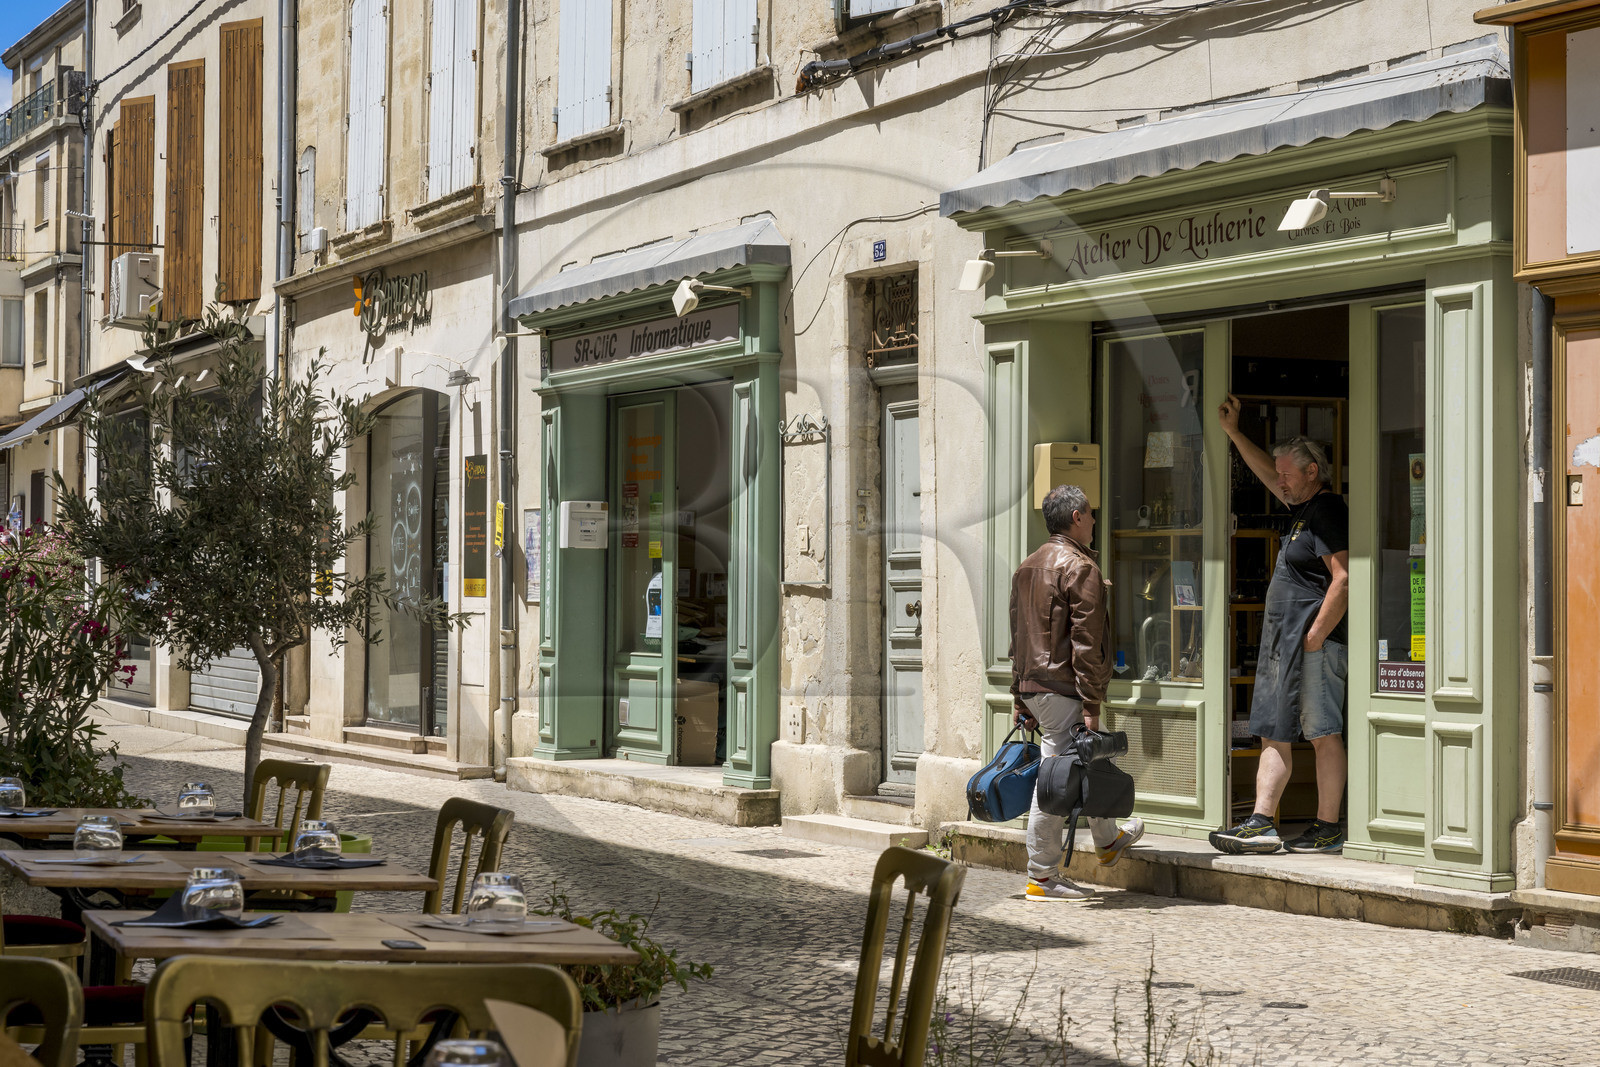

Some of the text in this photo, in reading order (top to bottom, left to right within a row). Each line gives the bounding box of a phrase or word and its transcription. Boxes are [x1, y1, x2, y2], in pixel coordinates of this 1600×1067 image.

[1324, 220, 1336, 234] Et
[1340, 216, 1361, 234] Bois
[1066, 207, 1266, 275] Atelier De Lutherie
[874, 244, 884, 258] 52
[630, 318, 712, 354] Informatique
[1380, 668, 1387, 676] En
[1397, 668, 1425, 677] d'absence
[1381, 679, 1424, 689] 06 23 12 05 36
